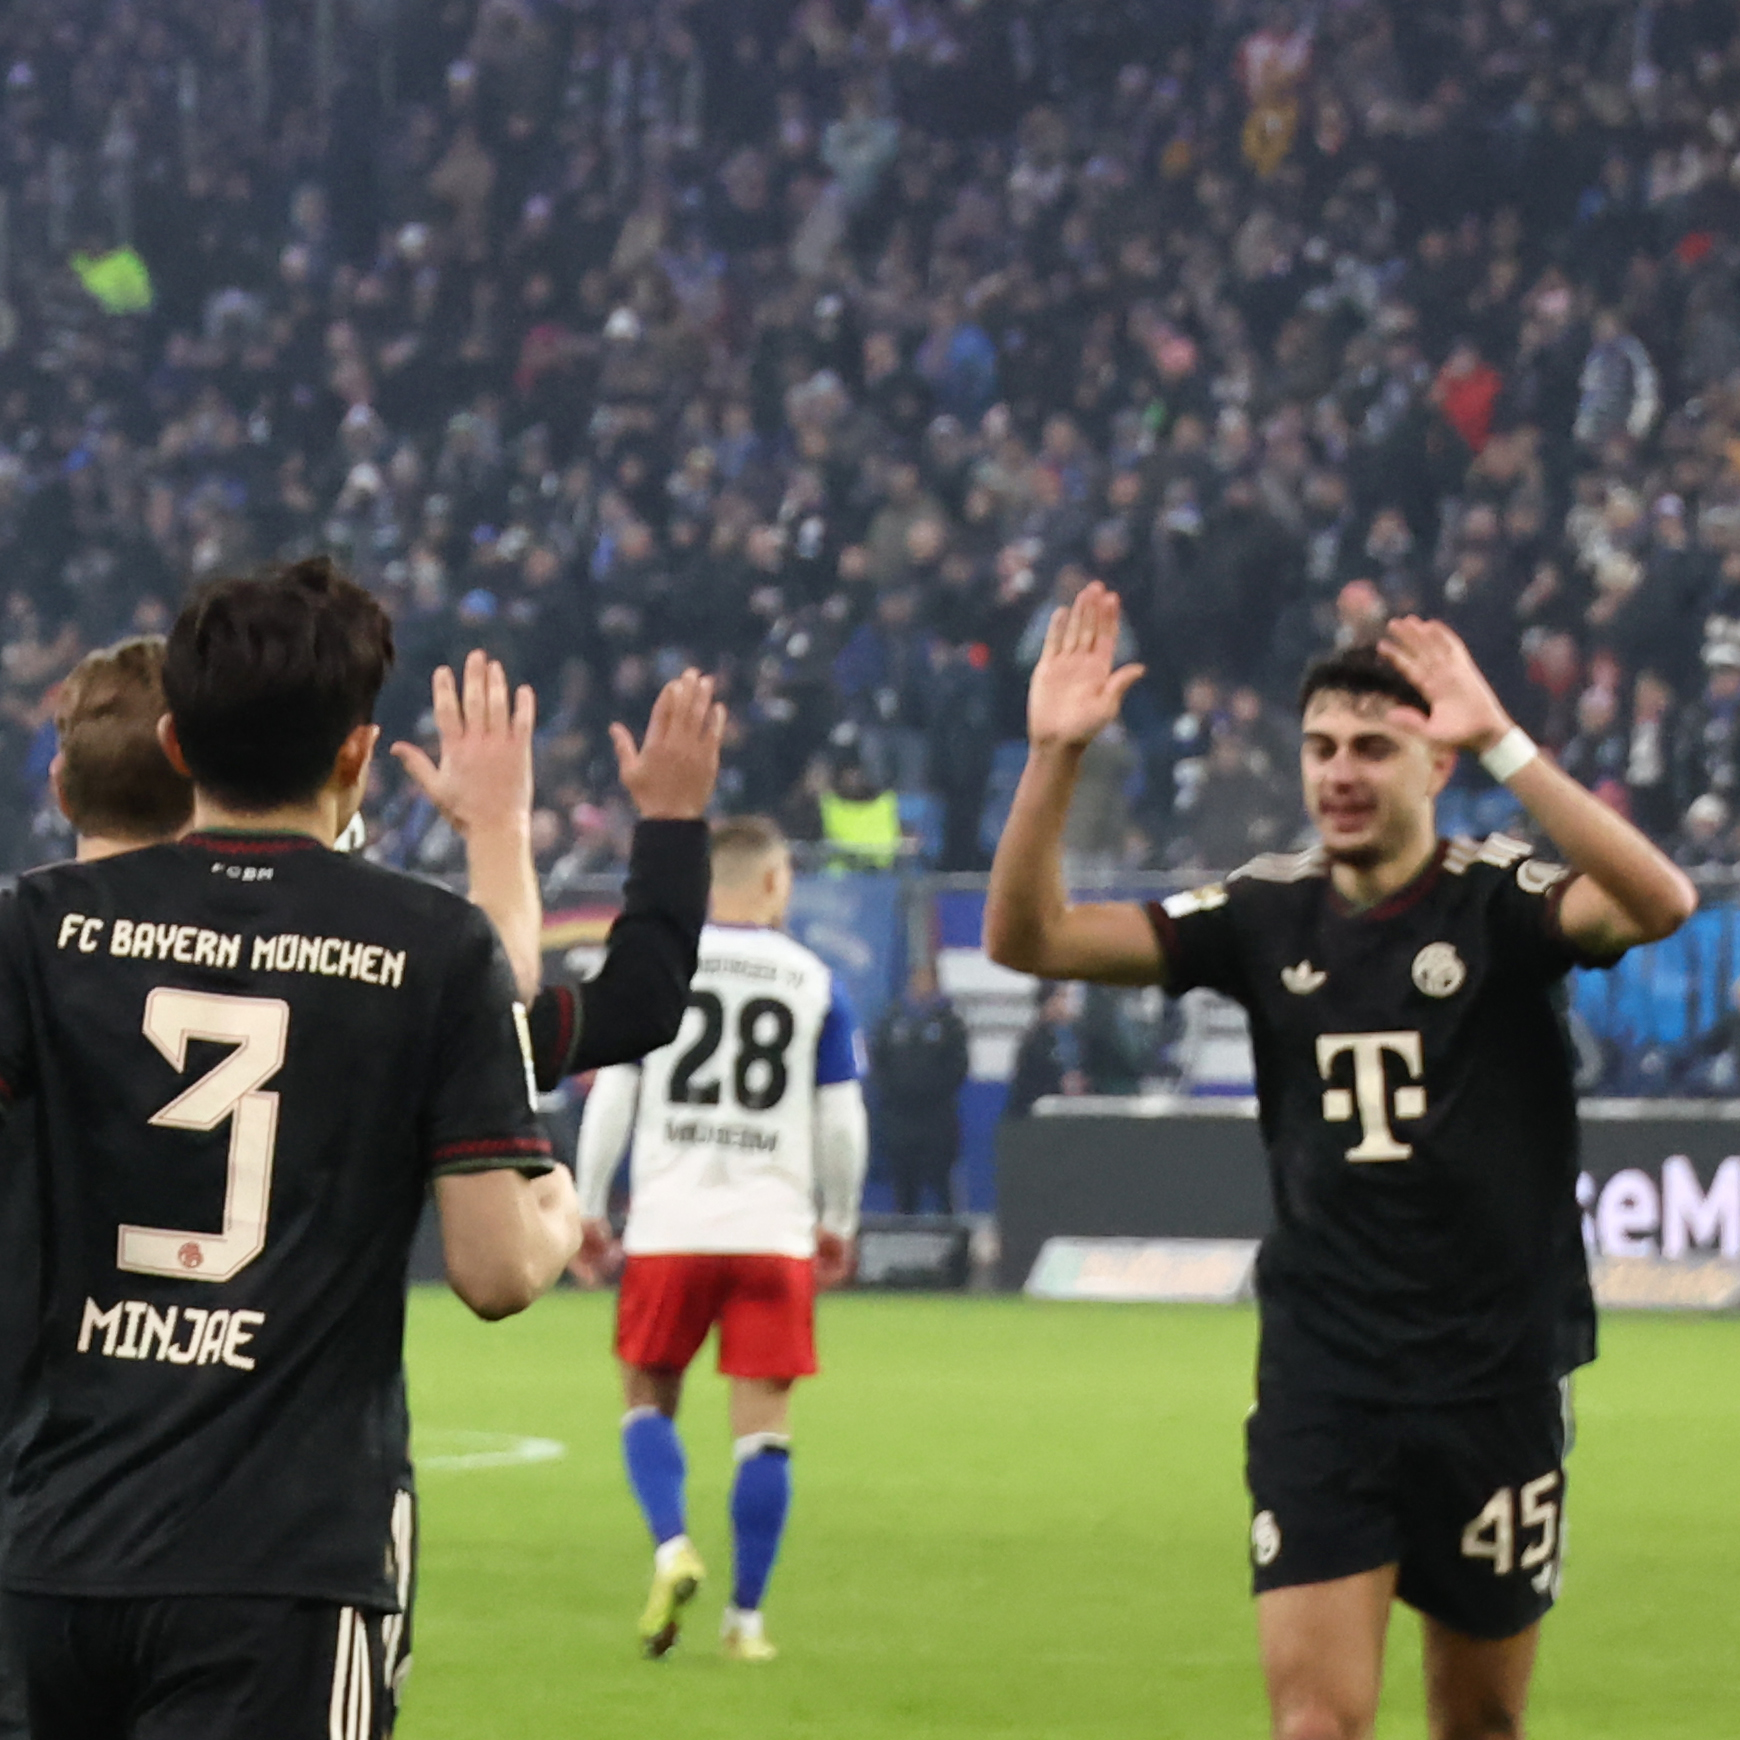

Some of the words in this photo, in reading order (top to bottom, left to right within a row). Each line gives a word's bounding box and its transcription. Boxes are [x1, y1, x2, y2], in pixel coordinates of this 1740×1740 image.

[58, 913, 104, 952] FC
[110, 918, 242, 969] BAYERN
[668, 989, 795, 1112] 28
[117, 986, 291, 1283] 3
[1576, 1153, 1740, 1260] eM
[77, 1296, 266, 1371] MINJAE
[1460, 1470, 1559, 1576] 45
